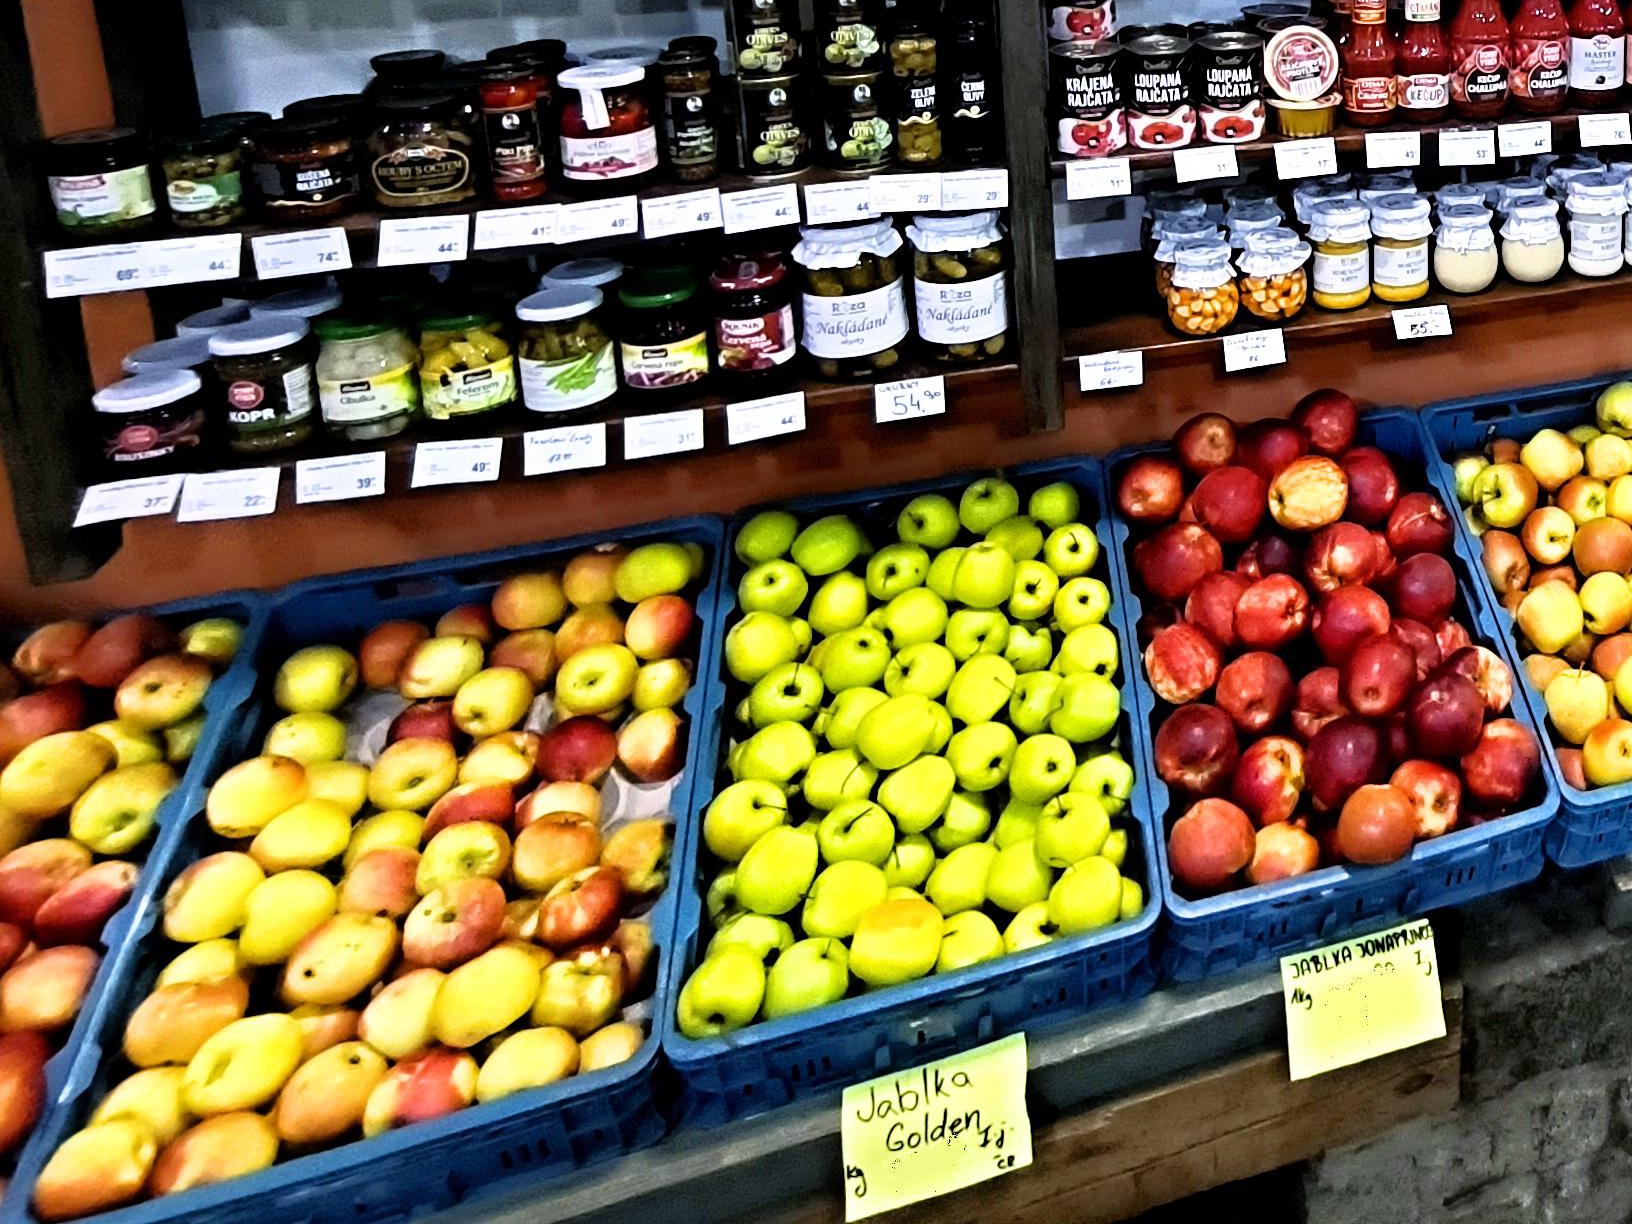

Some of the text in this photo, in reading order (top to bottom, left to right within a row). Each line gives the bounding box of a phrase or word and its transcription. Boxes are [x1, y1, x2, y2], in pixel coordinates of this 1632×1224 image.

[1066, 73, 1114, 92] KRÁJENÁ
[1134, 70, 1182, 88] LOUPANÁ
[1206, 65, 1253, 83] LOUPANÁ
[1067, 88, 1114, 107] RAJČATA
[1135, 85, 1182, 103] RAJČATA
[1208, 80, 1252, 98] RAJČATA
[229, 407, 276, 423] KOPR
[1289, 945, 1353, 980] JABLKA
[856, 1067, 974, 1124] Jablka
[885, 1107, 982, 1152] Golden
